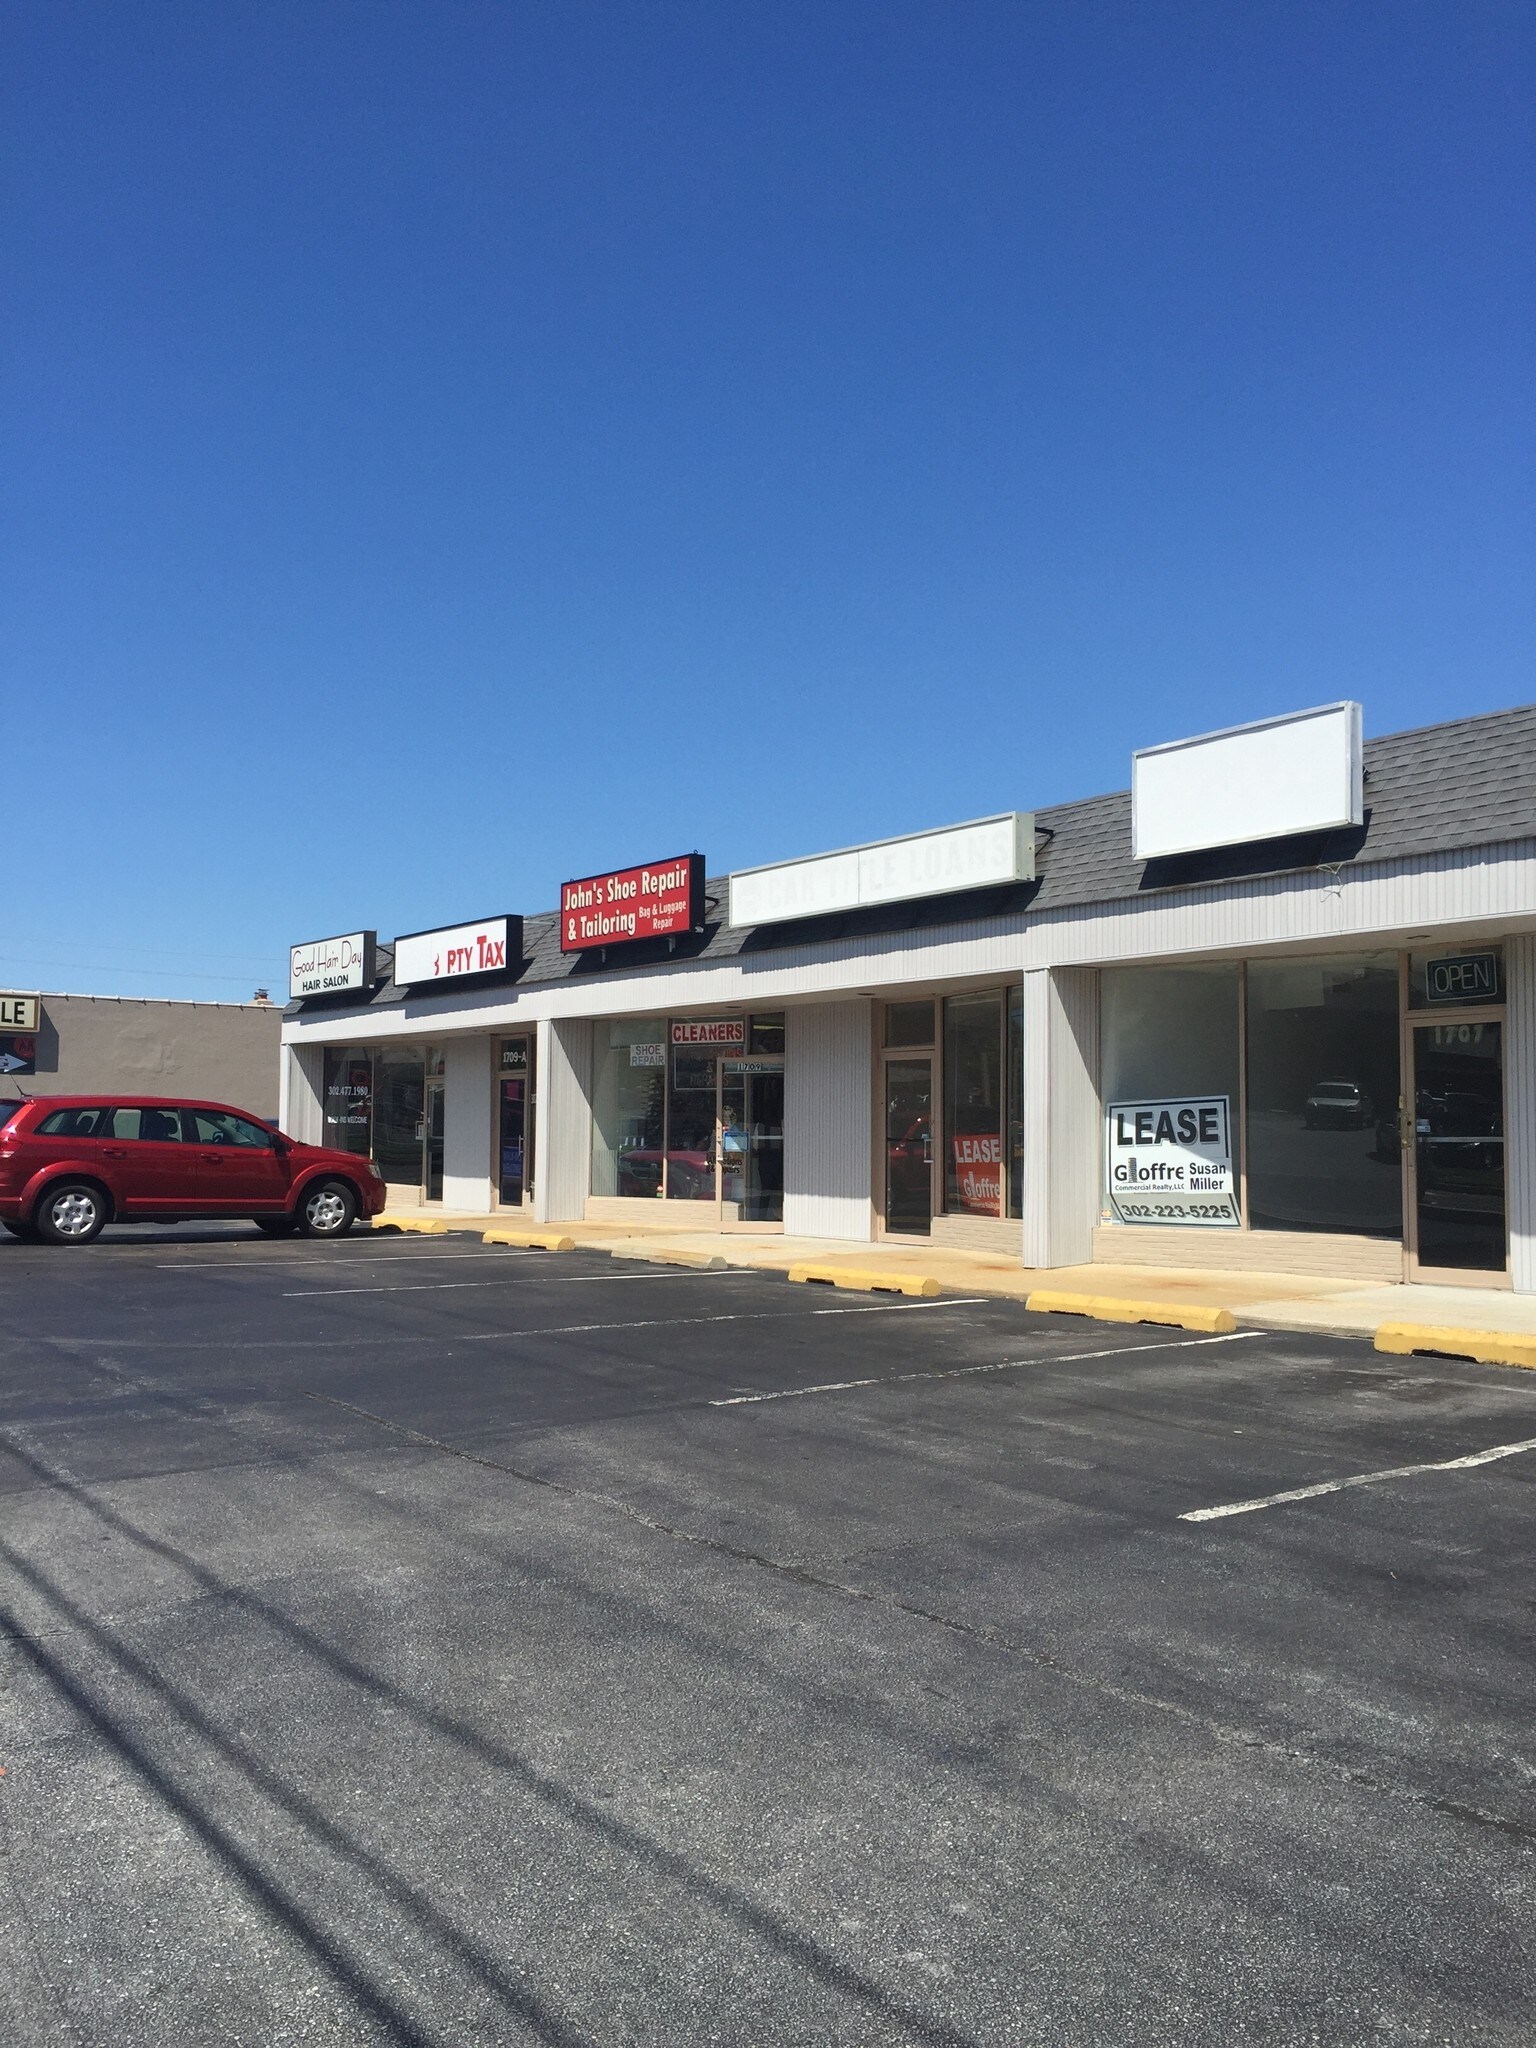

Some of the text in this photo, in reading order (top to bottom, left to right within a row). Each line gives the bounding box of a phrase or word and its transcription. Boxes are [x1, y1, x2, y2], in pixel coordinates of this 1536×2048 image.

[564, 864, 687, 912] John's Shoe Repair
[638, 900, 687, 919] Bag & Luggage
[567, 909, 636, 941] & Tailoring
[652, 916, 673, 930] Repair
[292, 940, 362, 978] Good Hair Day
[476, 935, 505, 969] TAX
[302, 974, 349, 992] HAIR SALON
[1434, 961, 1490, 993] OPEN
[673, 1024, 743, 1042] CLEANERS
[1434, 1024, 1484, 1044] 1707
[635, 1045, 661, 1056] SHOE
[631, 1056, 665, 1066] REPAIR
[1117, 1108, 1220, 1147] LEASE
[954, 1138, 1000, 1164] LEASE
[1189, 1162, 1226, 1175] Susan
[1190, 1178, 1224, 1190] Miller
[1121, 1204, 1232, 1219] 302-223-5225
